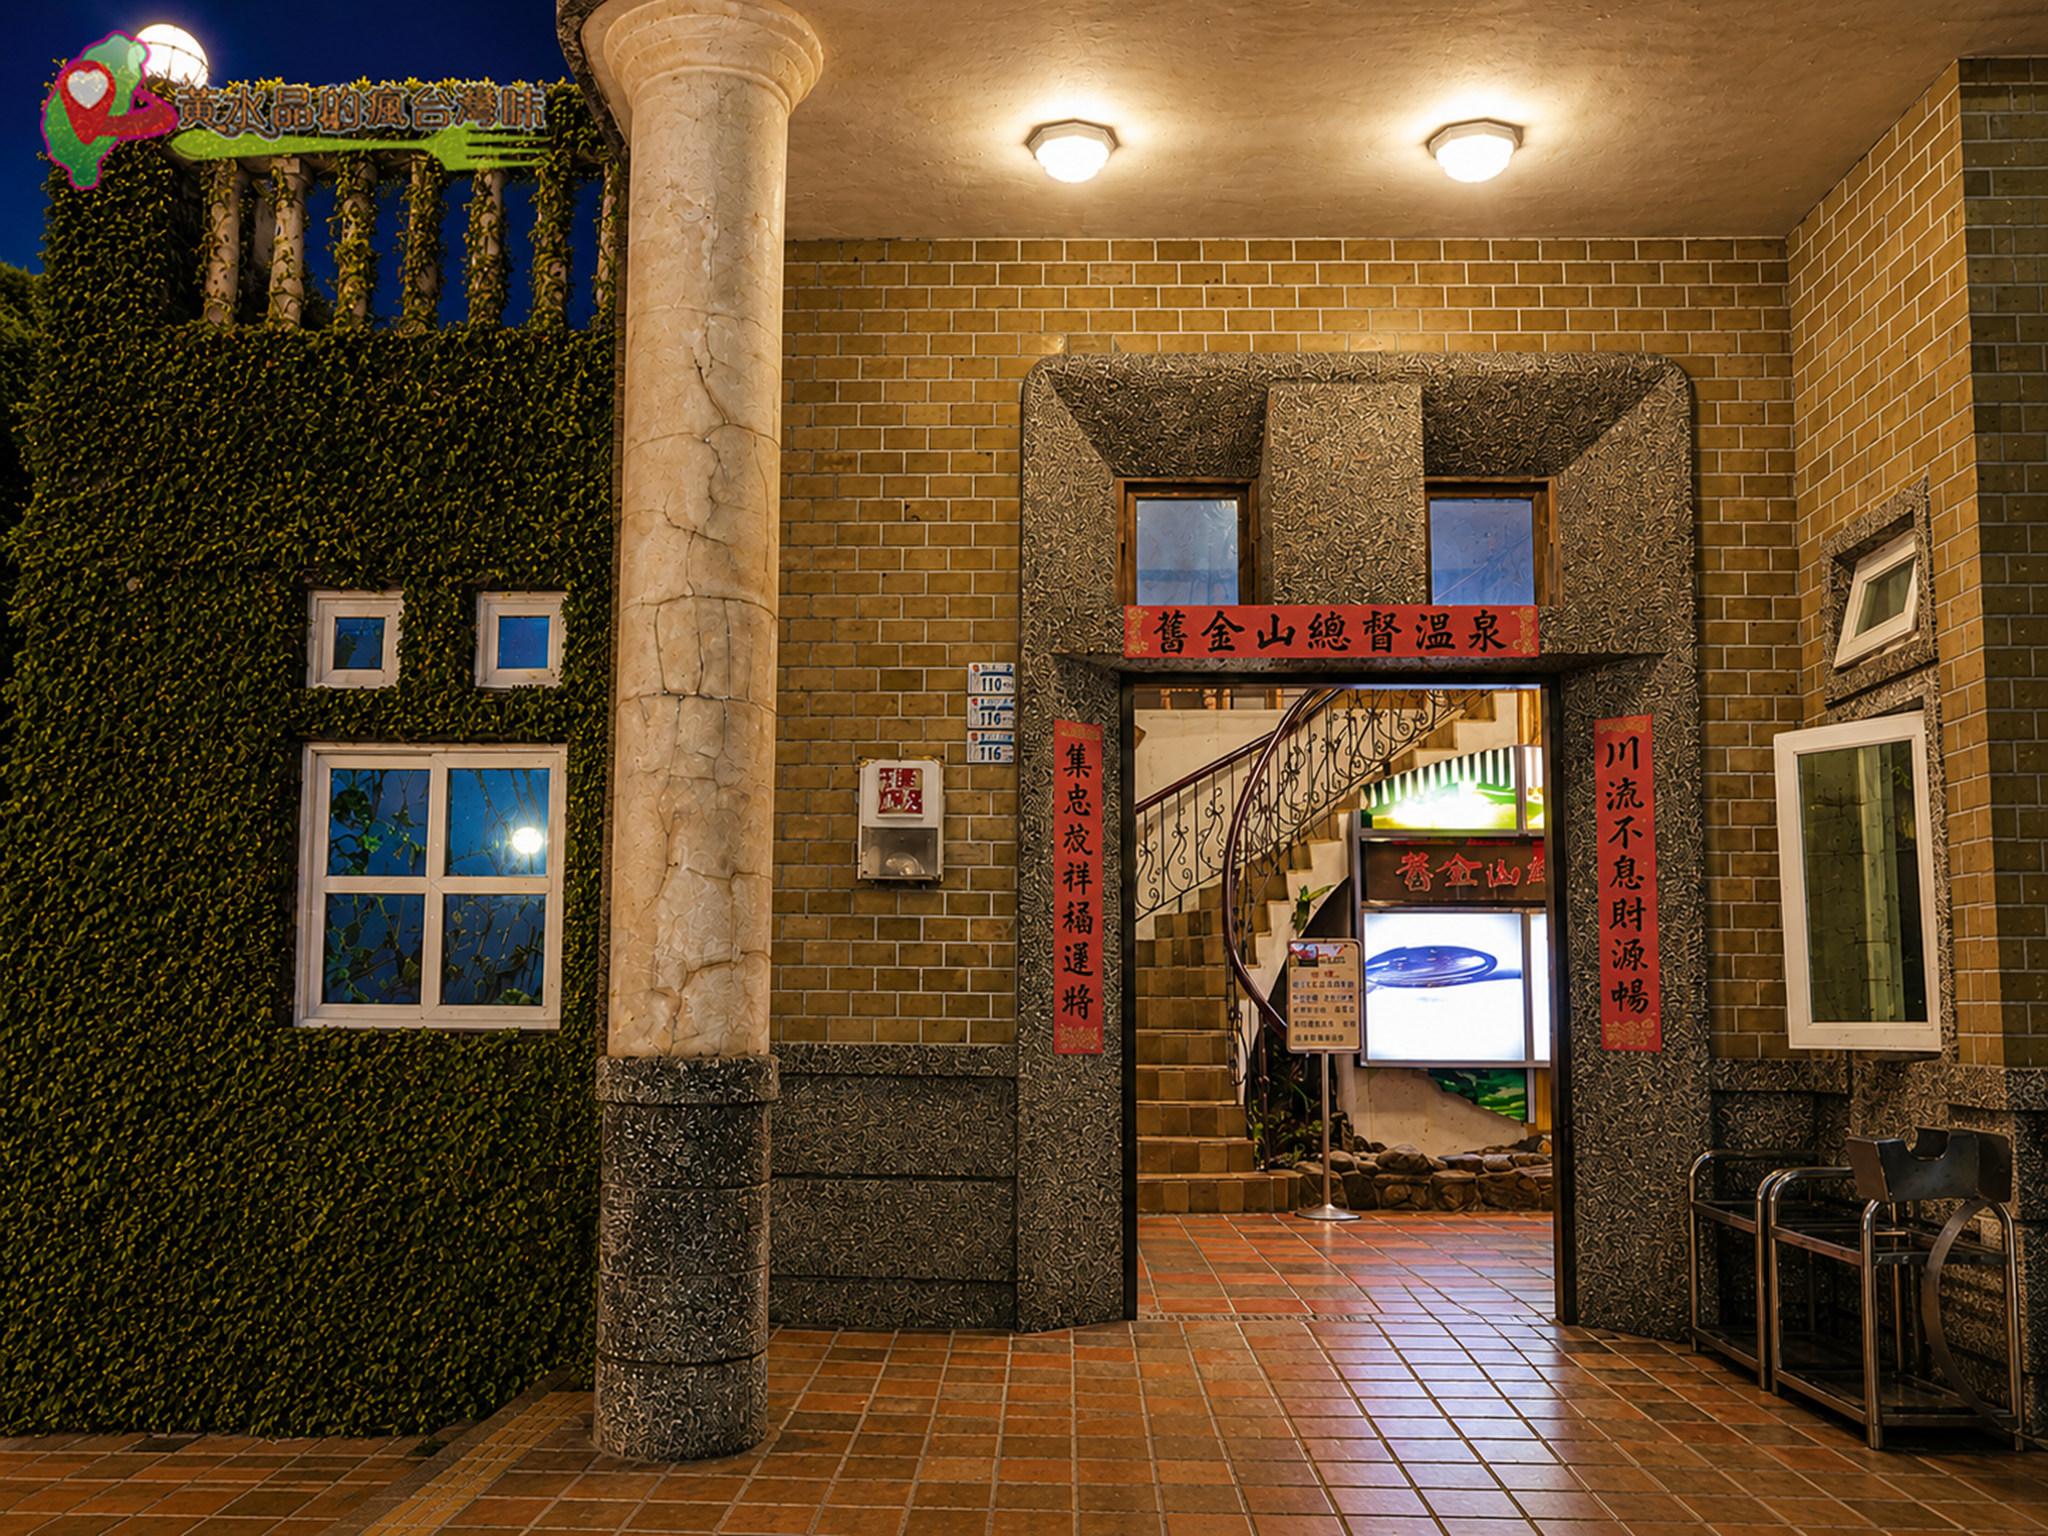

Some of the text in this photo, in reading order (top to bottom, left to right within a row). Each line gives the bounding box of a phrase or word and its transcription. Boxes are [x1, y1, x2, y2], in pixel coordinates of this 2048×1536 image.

[1153, 610, 1507, 653] 舊金山總督溫泉
[1605, 736, 1648, 1014] 川流不息財源暢
